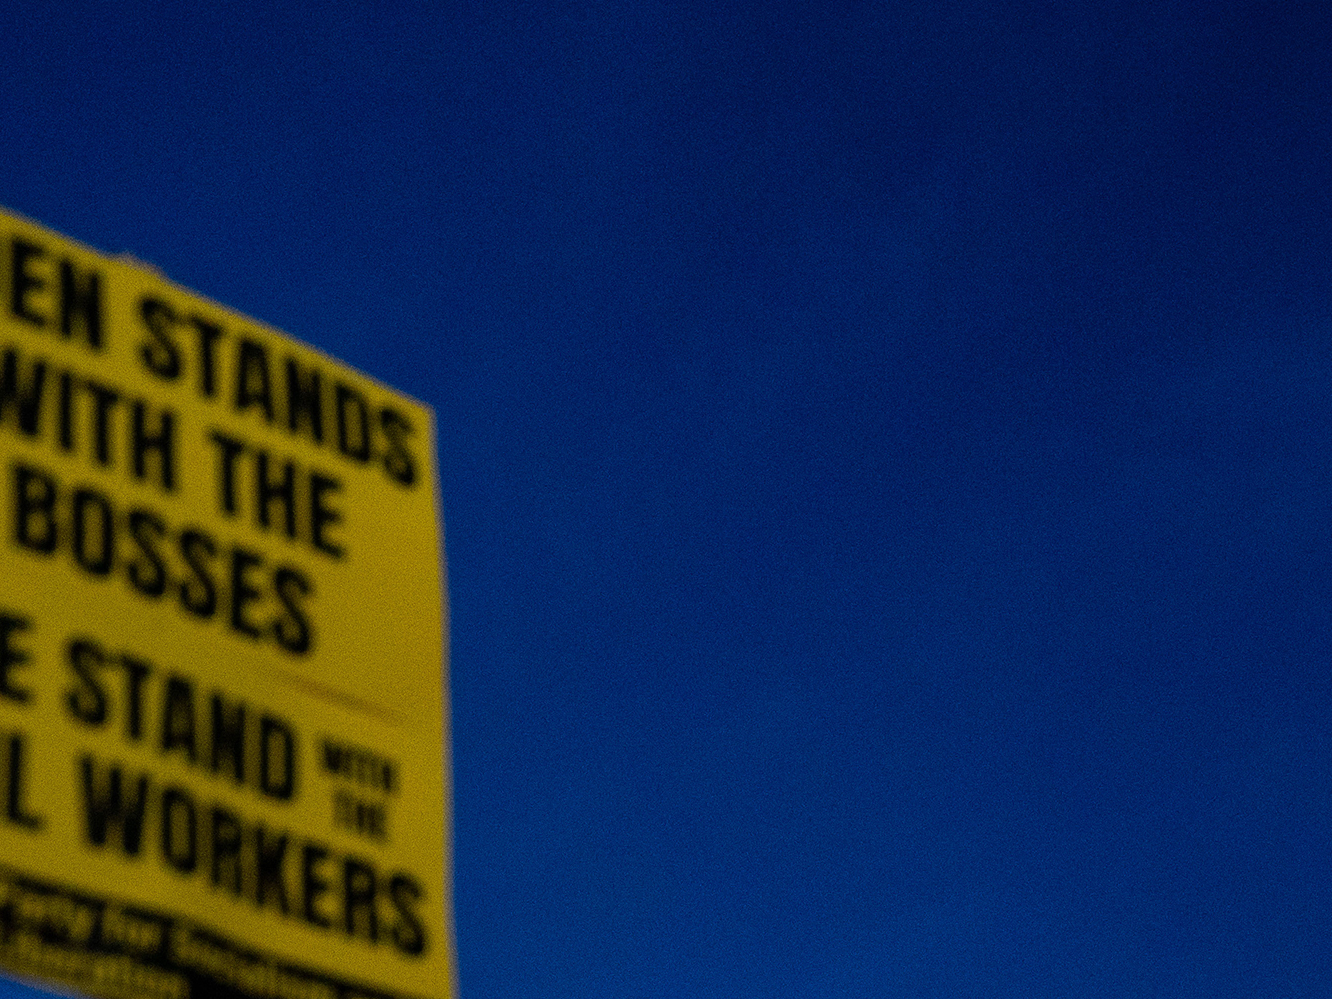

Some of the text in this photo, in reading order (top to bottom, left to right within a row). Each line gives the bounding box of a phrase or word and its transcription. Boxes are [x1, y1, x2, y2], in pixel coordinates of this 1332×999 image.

[9, 233, 418, 488] EN STANDS
[13, 462, 313, 655] BOSSES
[208, 428, 346, 561] THE
[0, 611, 296, 800] E STAND
[8, 732, 428, 957] L WORKERS
